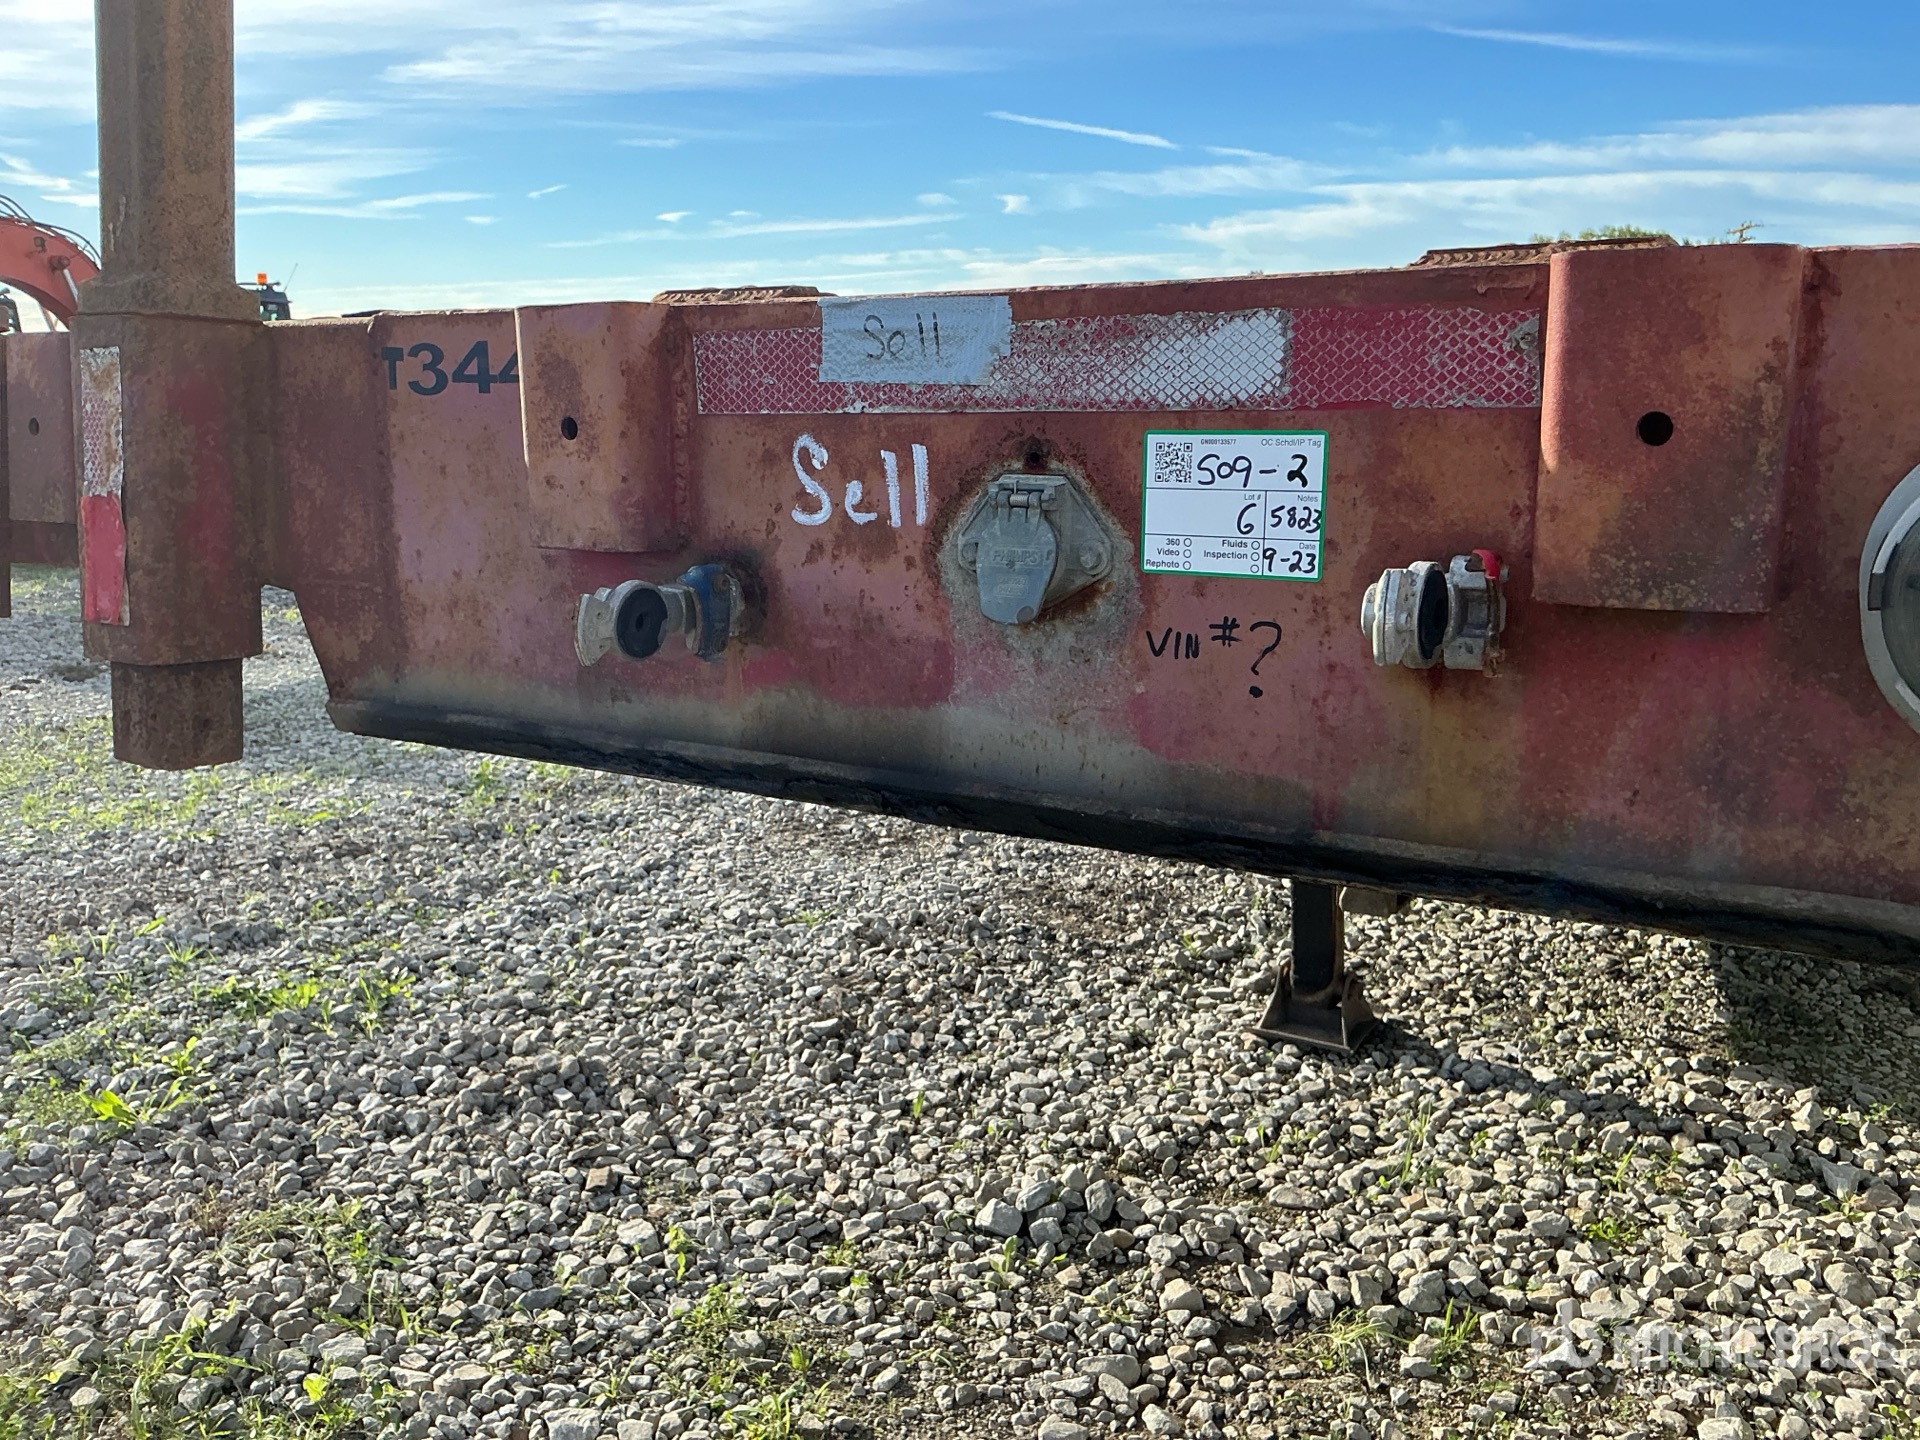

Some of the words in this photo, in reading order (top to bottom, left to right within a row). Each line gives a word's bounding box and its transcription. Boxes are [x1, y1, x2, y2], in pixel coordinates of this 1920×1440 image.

[863, 312, 942, 361] Sell
[1260, 438, 1275, 447] OC
[1307, 439, 1322, 448] Tag
[791, 432, 929, 528] Sell
[1244, 493, 1256, 501] Lot
[1297, 494, 1319, 503] Notes
[1236, 502, 1257, 535] 6
[1270, 505, 1322, 534] 5823
[1165, 538, 1180, 547] 360
[1221, 539, 1249, 549] Fluids
[1157, 547, 1180, 557] Video
[1203, 550, 1248, 562] Inspection
[1145, 559, 1180, 569] Rephoto
